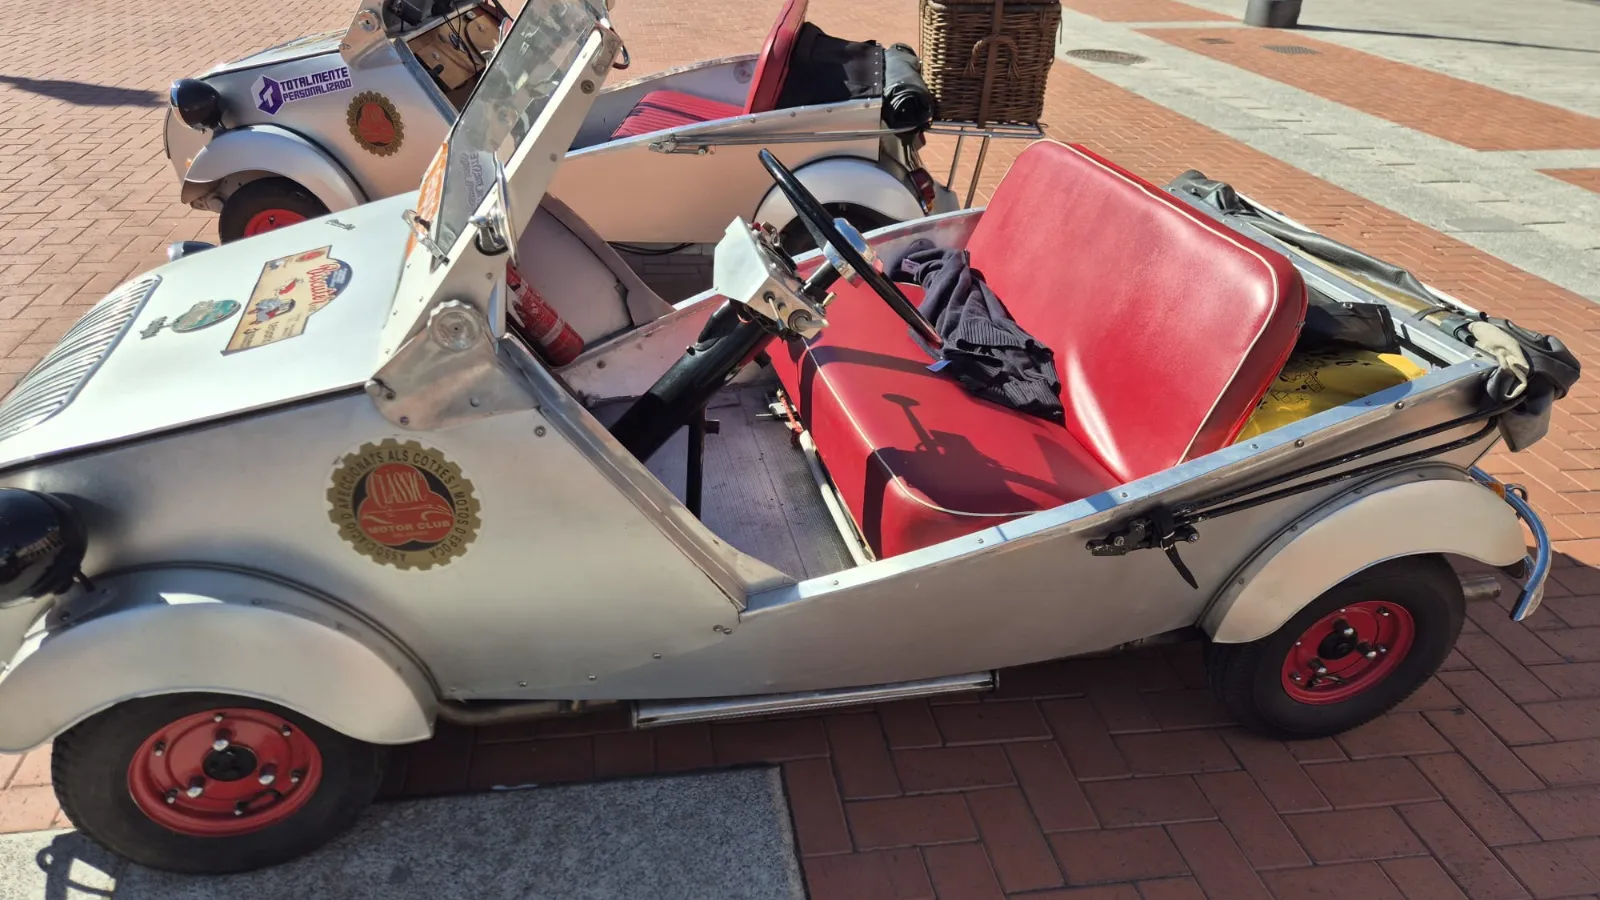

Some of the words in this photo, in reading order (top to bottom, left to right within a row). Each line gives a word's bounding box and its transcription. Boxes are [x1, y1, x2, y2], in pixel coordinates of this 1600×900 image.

[280, 67, 349, 91] TOTALMENTE
[283, 79, 352, 101] PERSONALIZADO
[388, 450, 409, 462] ALS
[413, 452, 455, 484] COTXES
[455, 491, 470, 525] MOTOS
[368, 524, 413, 534] MOTOR
[417, 520, 450, 530] CLUB
